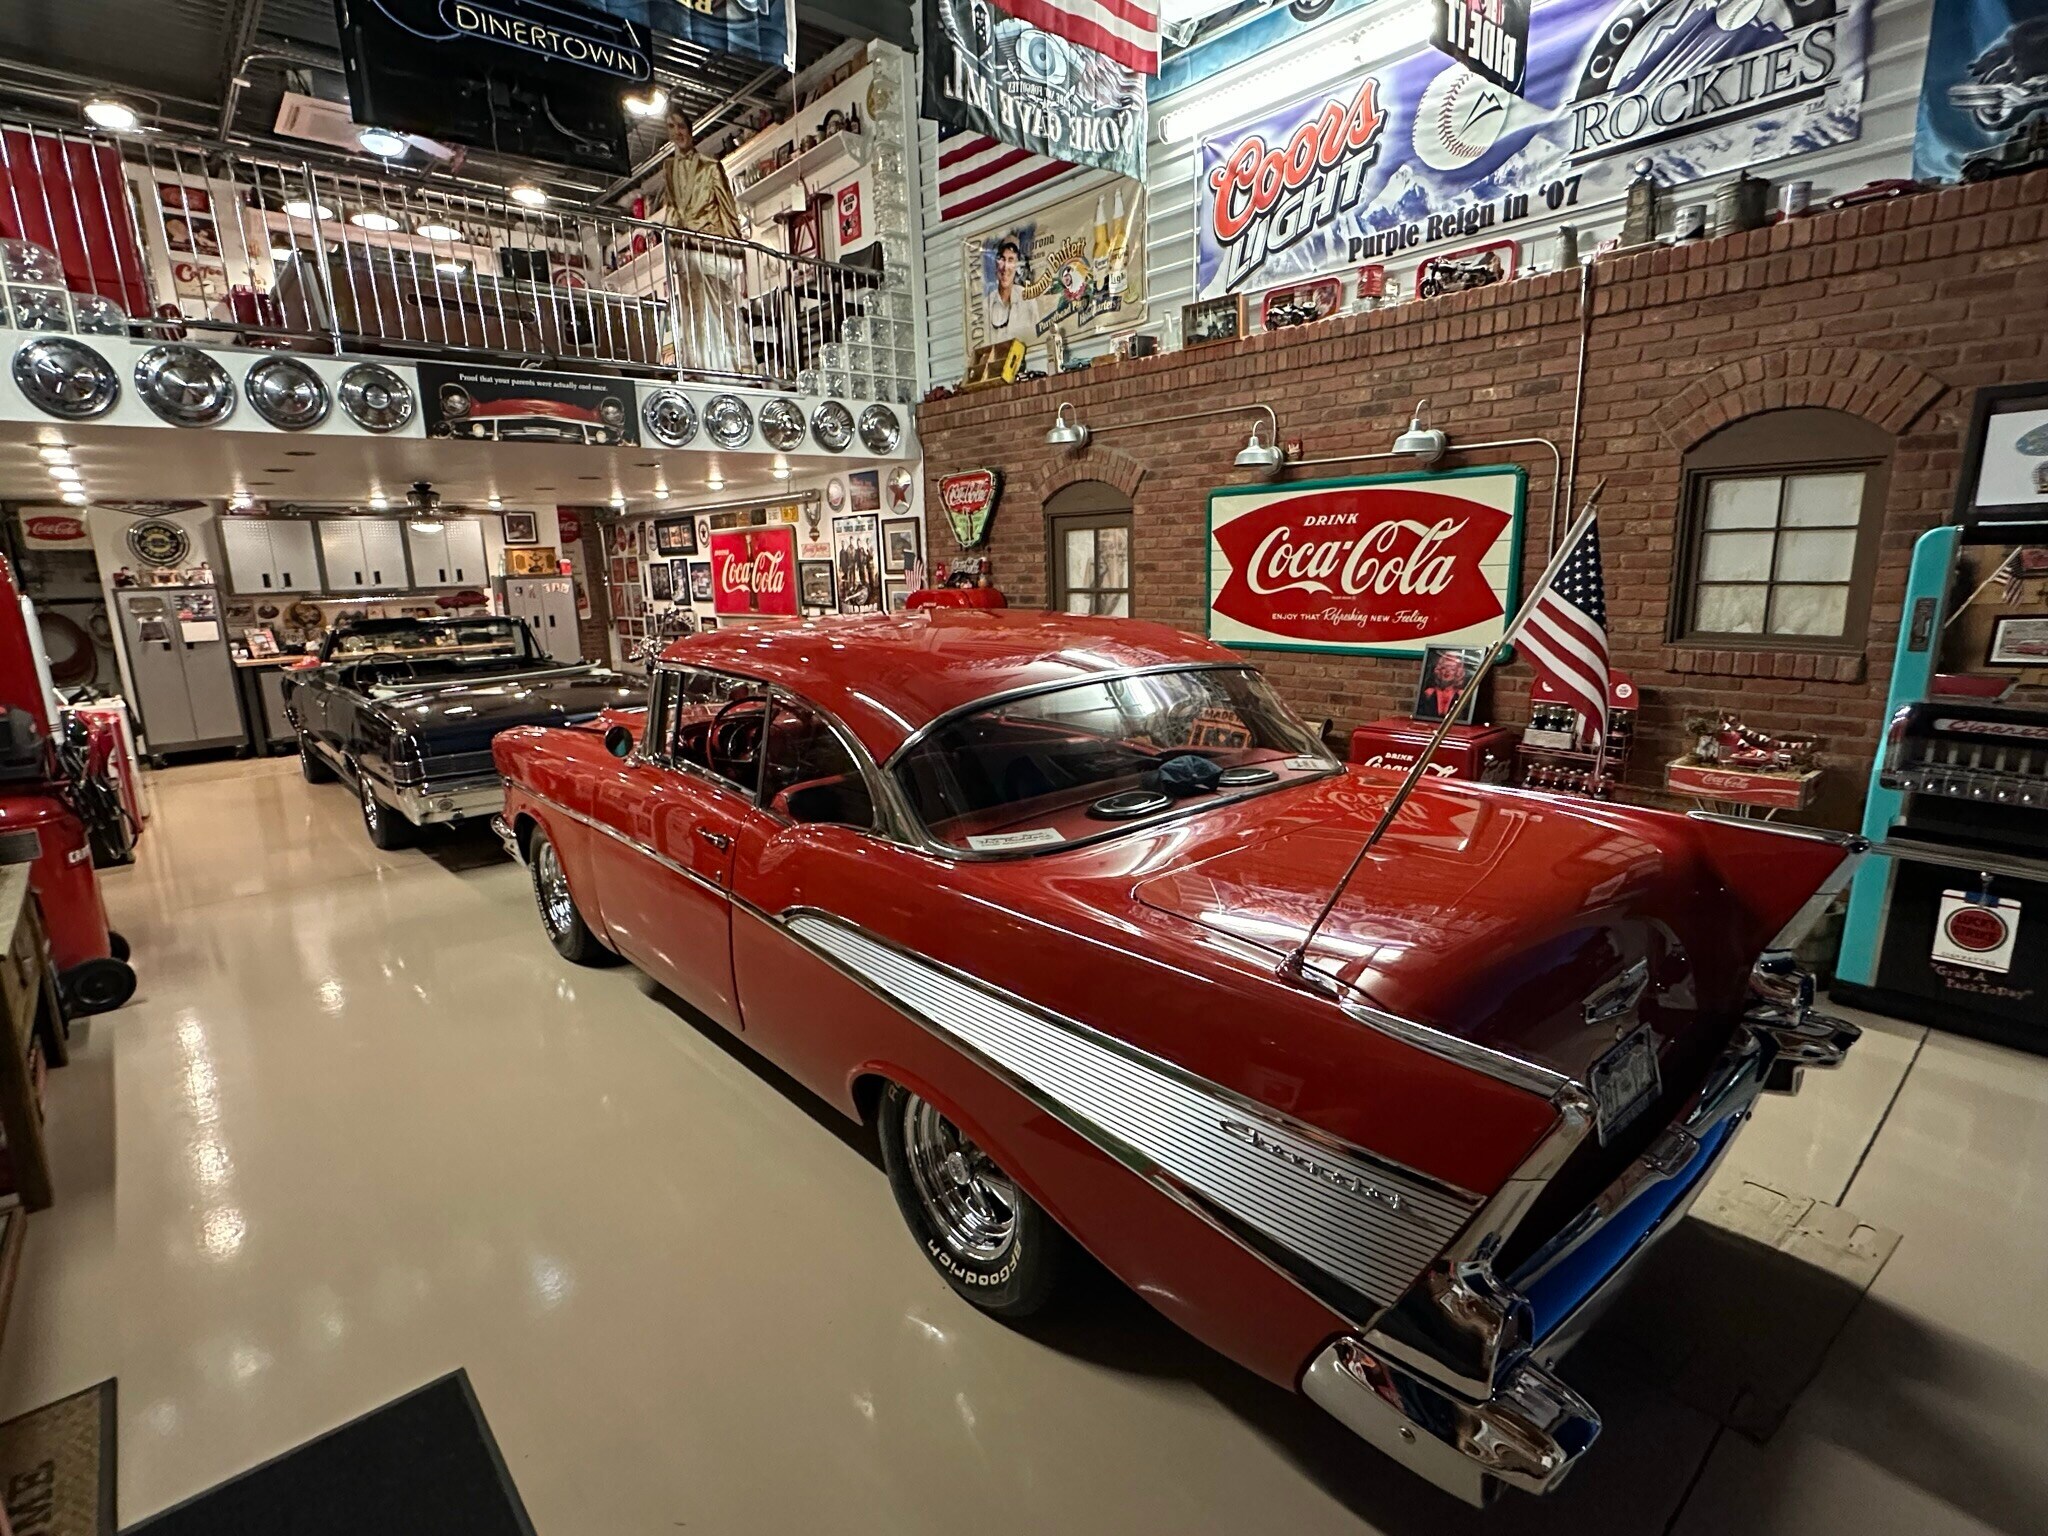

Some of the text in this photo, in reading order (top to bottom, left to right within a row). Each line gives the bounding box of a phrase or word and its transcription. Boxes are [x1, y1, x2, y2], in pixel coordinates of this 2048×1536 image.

[456, 5, 637, 75] DINERTOWN
[1570, 24, 1837, 155] ROCKIES
[1210, 78, 1386, 242] Coors
[1226, 145, 1377, 291] LIGHT
[1348, 227, 1420, 262] Purple
[1426, 202, 1495, 242] Reign
[1502, 193, 1529, 223] in
[1023, 236, 1087, 301] Jimmy Buffett
[459, 373, 478, 382] Proof
[479, 374, 494, 383] that
[494, 377, 510, 386] your
[511, 379, 536, 387] parents
[553, 381, 578, 391] actually
[1303, 512, 1360, 527] DRINK
[721, 550, 786, 594] Coca-Cola
[1246, 515, 1471, 596] Coca-Cola
[1271, 606, 1429, 630] ENJOY THAT Refreshing NEW Feeling
[1385, 751, 1414, 762] DRINK
